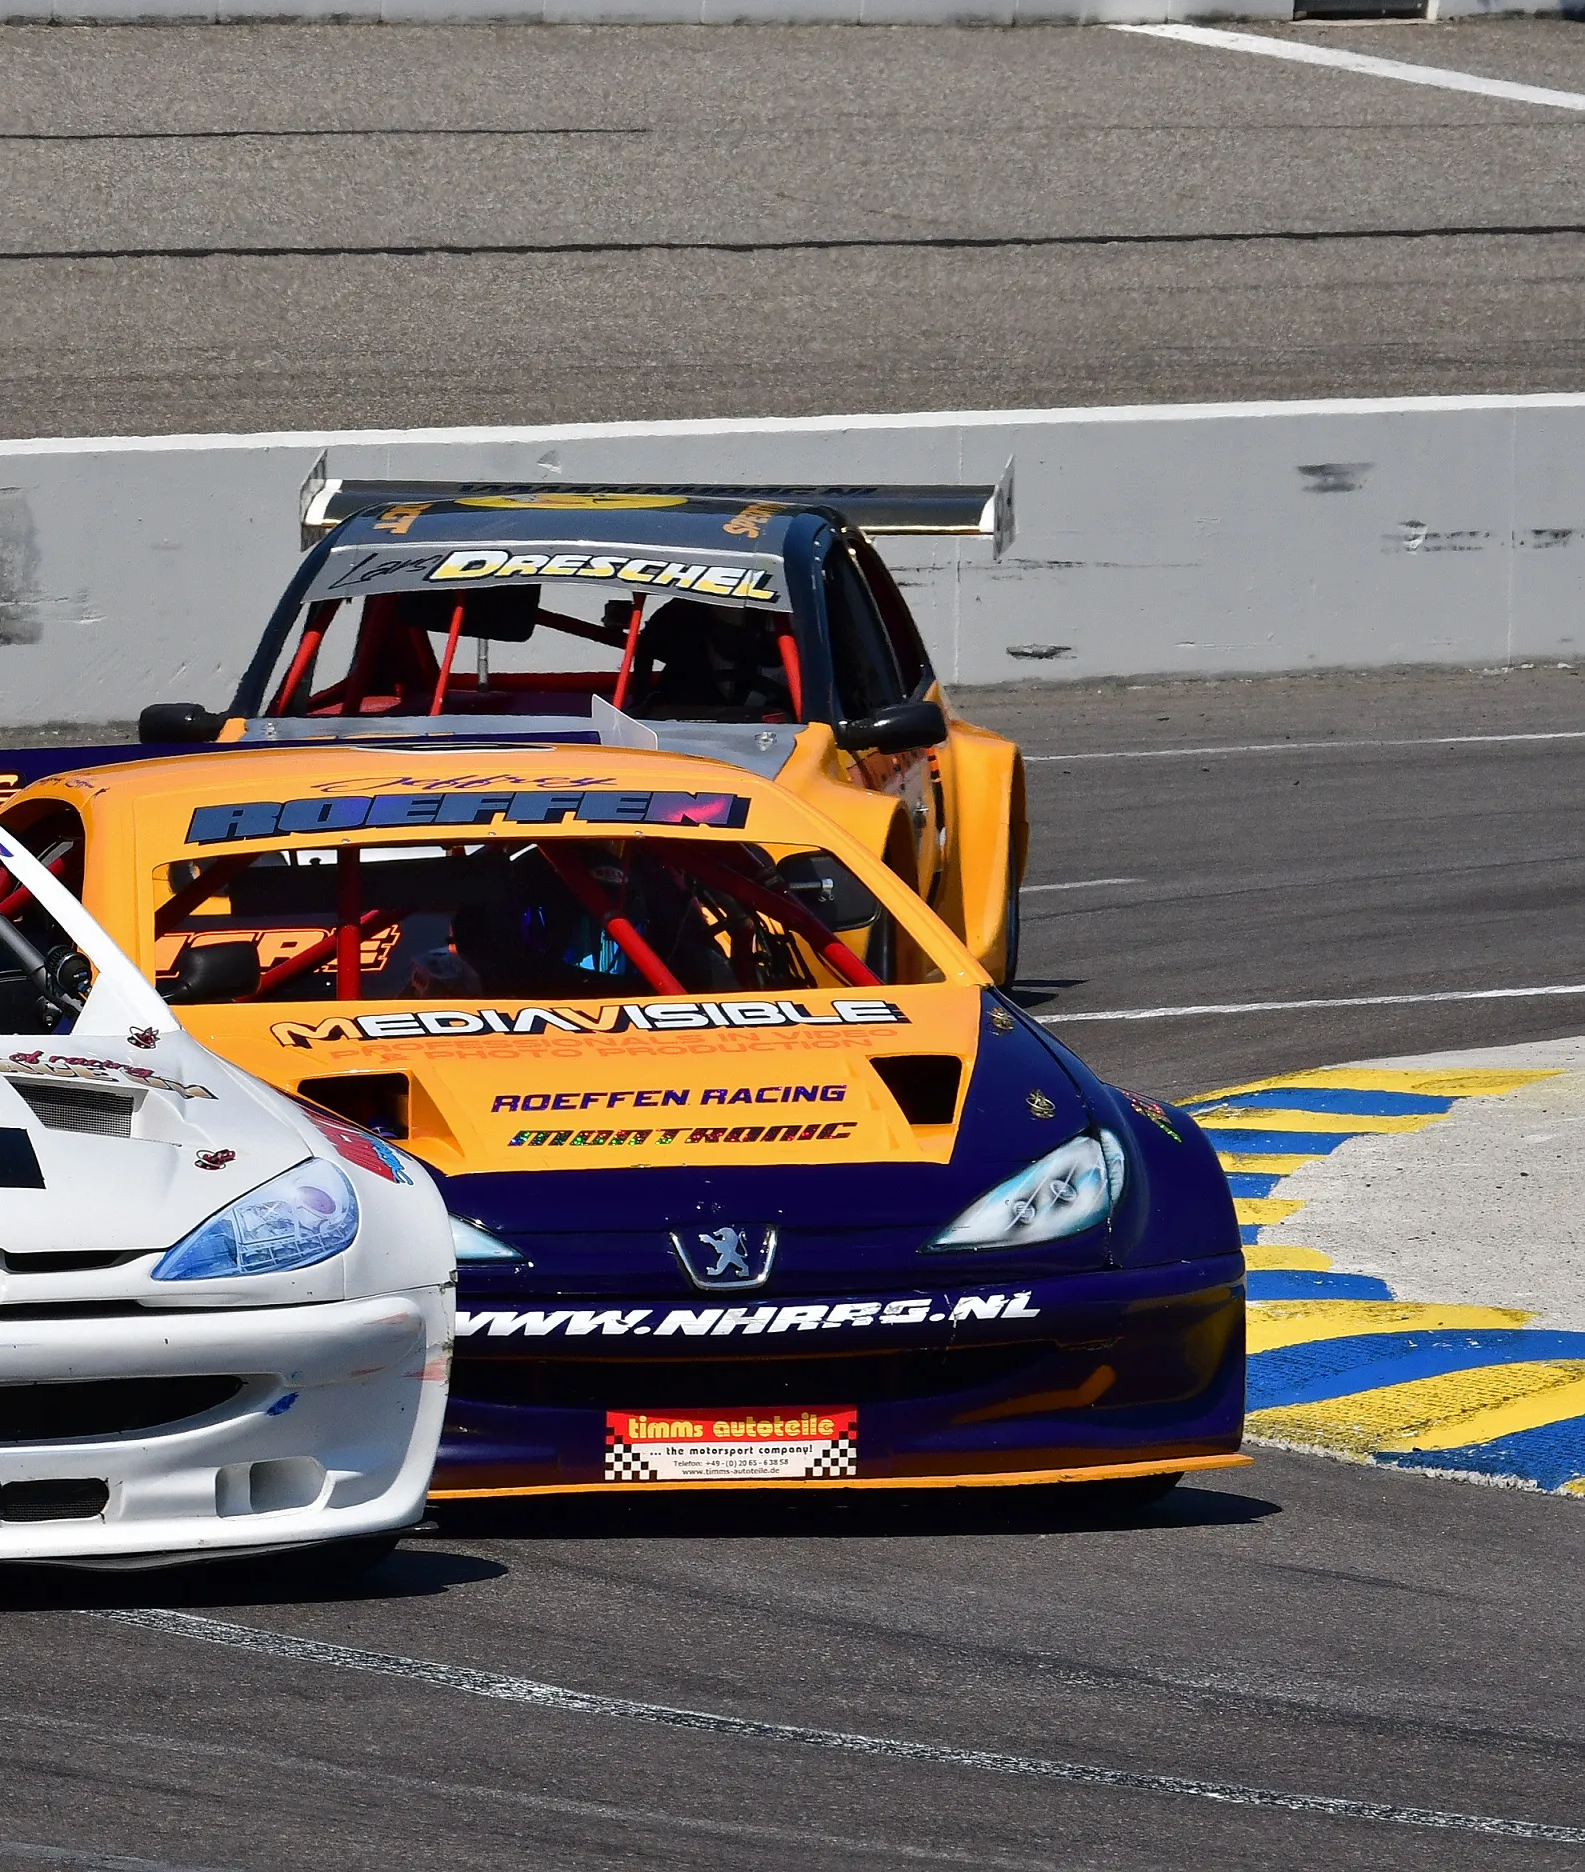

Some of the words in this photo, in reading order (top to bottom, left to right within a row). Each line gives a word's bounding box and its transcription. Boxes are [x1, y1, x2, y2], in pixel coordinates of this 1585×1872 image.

[329, 552, 443, 589] Lars
[429, 550, 781, 602] DRESCHEL
[311, 773, 618, 793] Jeffrey
[184, 790, 752, 845] ROEFFEN
[270, 1000, 912, 1049] MEDIAVISIBLE
[331, 1033, 698, 1060] PROFESSIONALS
[718, 1032, 759, 1042] IN
[781, 1028, 898, 1041] VIDEO
[426, 1049, 583, 1060] PHOTO
[597, 1038, 873, 1058] PRODUCTION
[9, 1050, 44, 1065] of
[49, 1055, 155, 1078] racing
[490, 1088, 691, 1113] ROEFFEN
[699, 1084, 848, 1106] RACING
[628, 1415, 704, 1440] timms
[712, 1412, 835, 1439] autoteile
[666, 1446, 685, 1456] the
[689, 1446, 755, 1458] motorsport
[758, 1444, 813, 1456] company!
[681, 1467, 780, 1475] www.timms-autoteile.de
